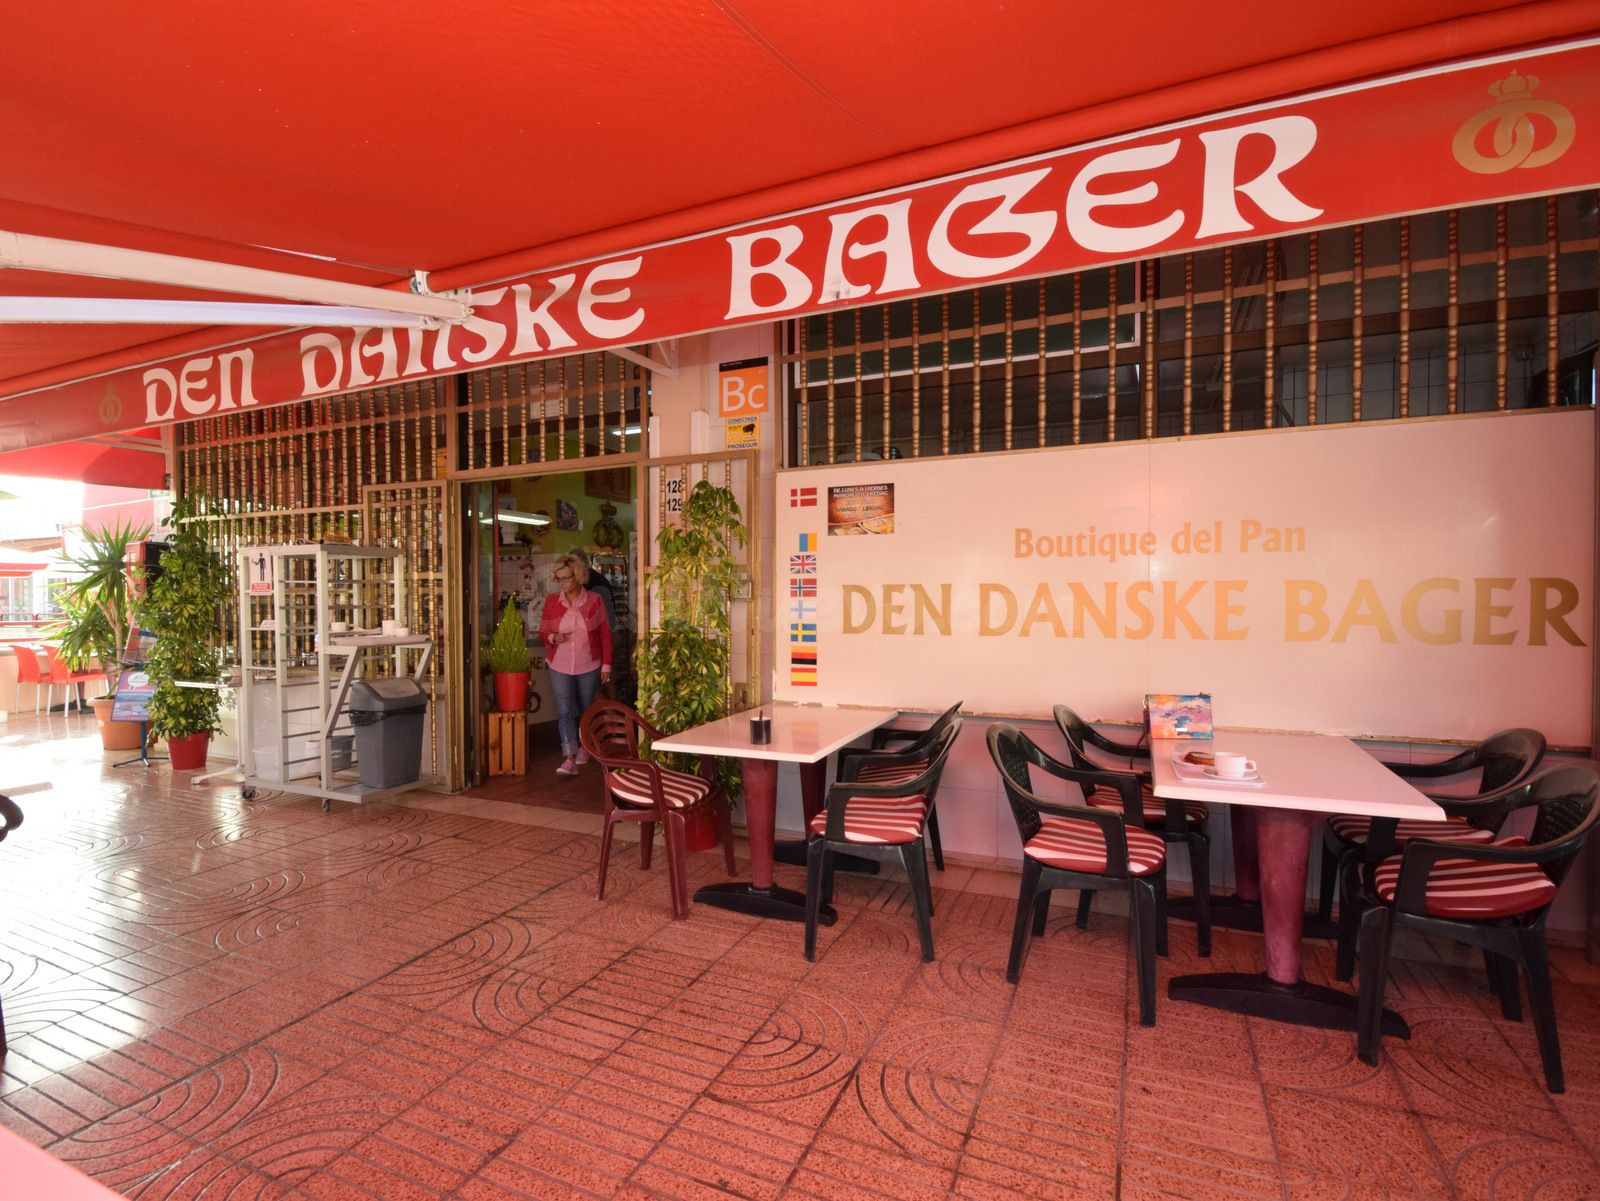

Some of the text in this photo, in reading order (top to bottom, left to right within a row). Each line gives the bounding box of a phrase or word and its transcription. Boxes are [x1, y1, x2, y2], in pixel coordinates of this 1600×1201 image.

[144, 115, 1325, 424] DEN DANSKE BAGER
[723, 376, 765, 412] Bc
[1014, 518, 1306, 562] Boutique del Pan
[841, 583, 952, 636] DEN
[977, 580, 1251, 640] DANSKE
[1282, 576, 1588, 647] BAGER
